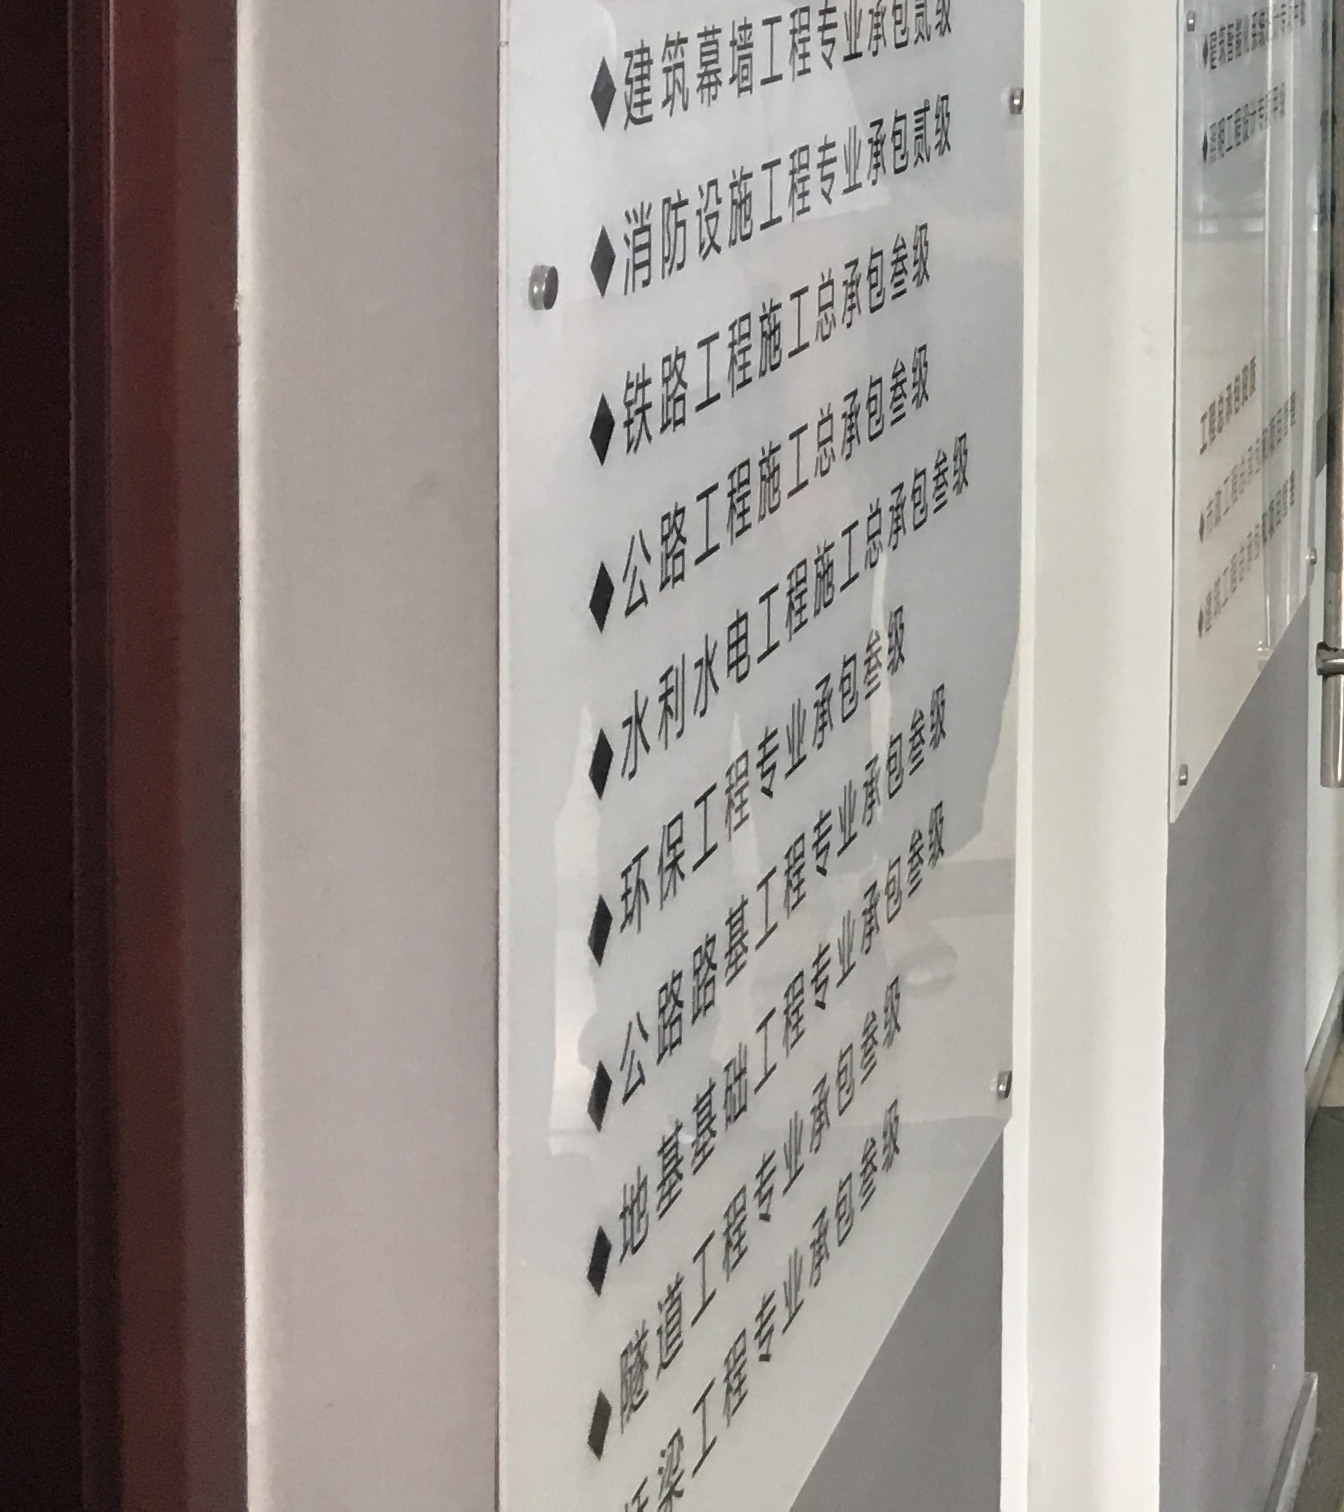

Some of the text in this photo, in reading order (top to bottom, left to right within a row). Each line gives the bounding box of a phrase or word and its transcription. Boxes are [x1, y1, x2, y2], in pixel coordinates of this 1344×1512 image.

[622, 222, 930, 455] 铁路工程施工总承包叁级
[623, 94, 951, 295] 消防设施工程专业承包贰级
[621, 433, 969, 780] 水利水电工程施工总承包叁级
[622, 343, 929, 618] 公路工程施工总承包叁级
[620, 605, 905, 934] 环保工程专业承包叁级
[620, 684, 946, 1105] 公路路基工程专业承包叁级
[619, 801, 945, 1265] 地基基础工程专业承包叁级
[620, 976, 900, 1434] 隧道工程专业承包叁级
